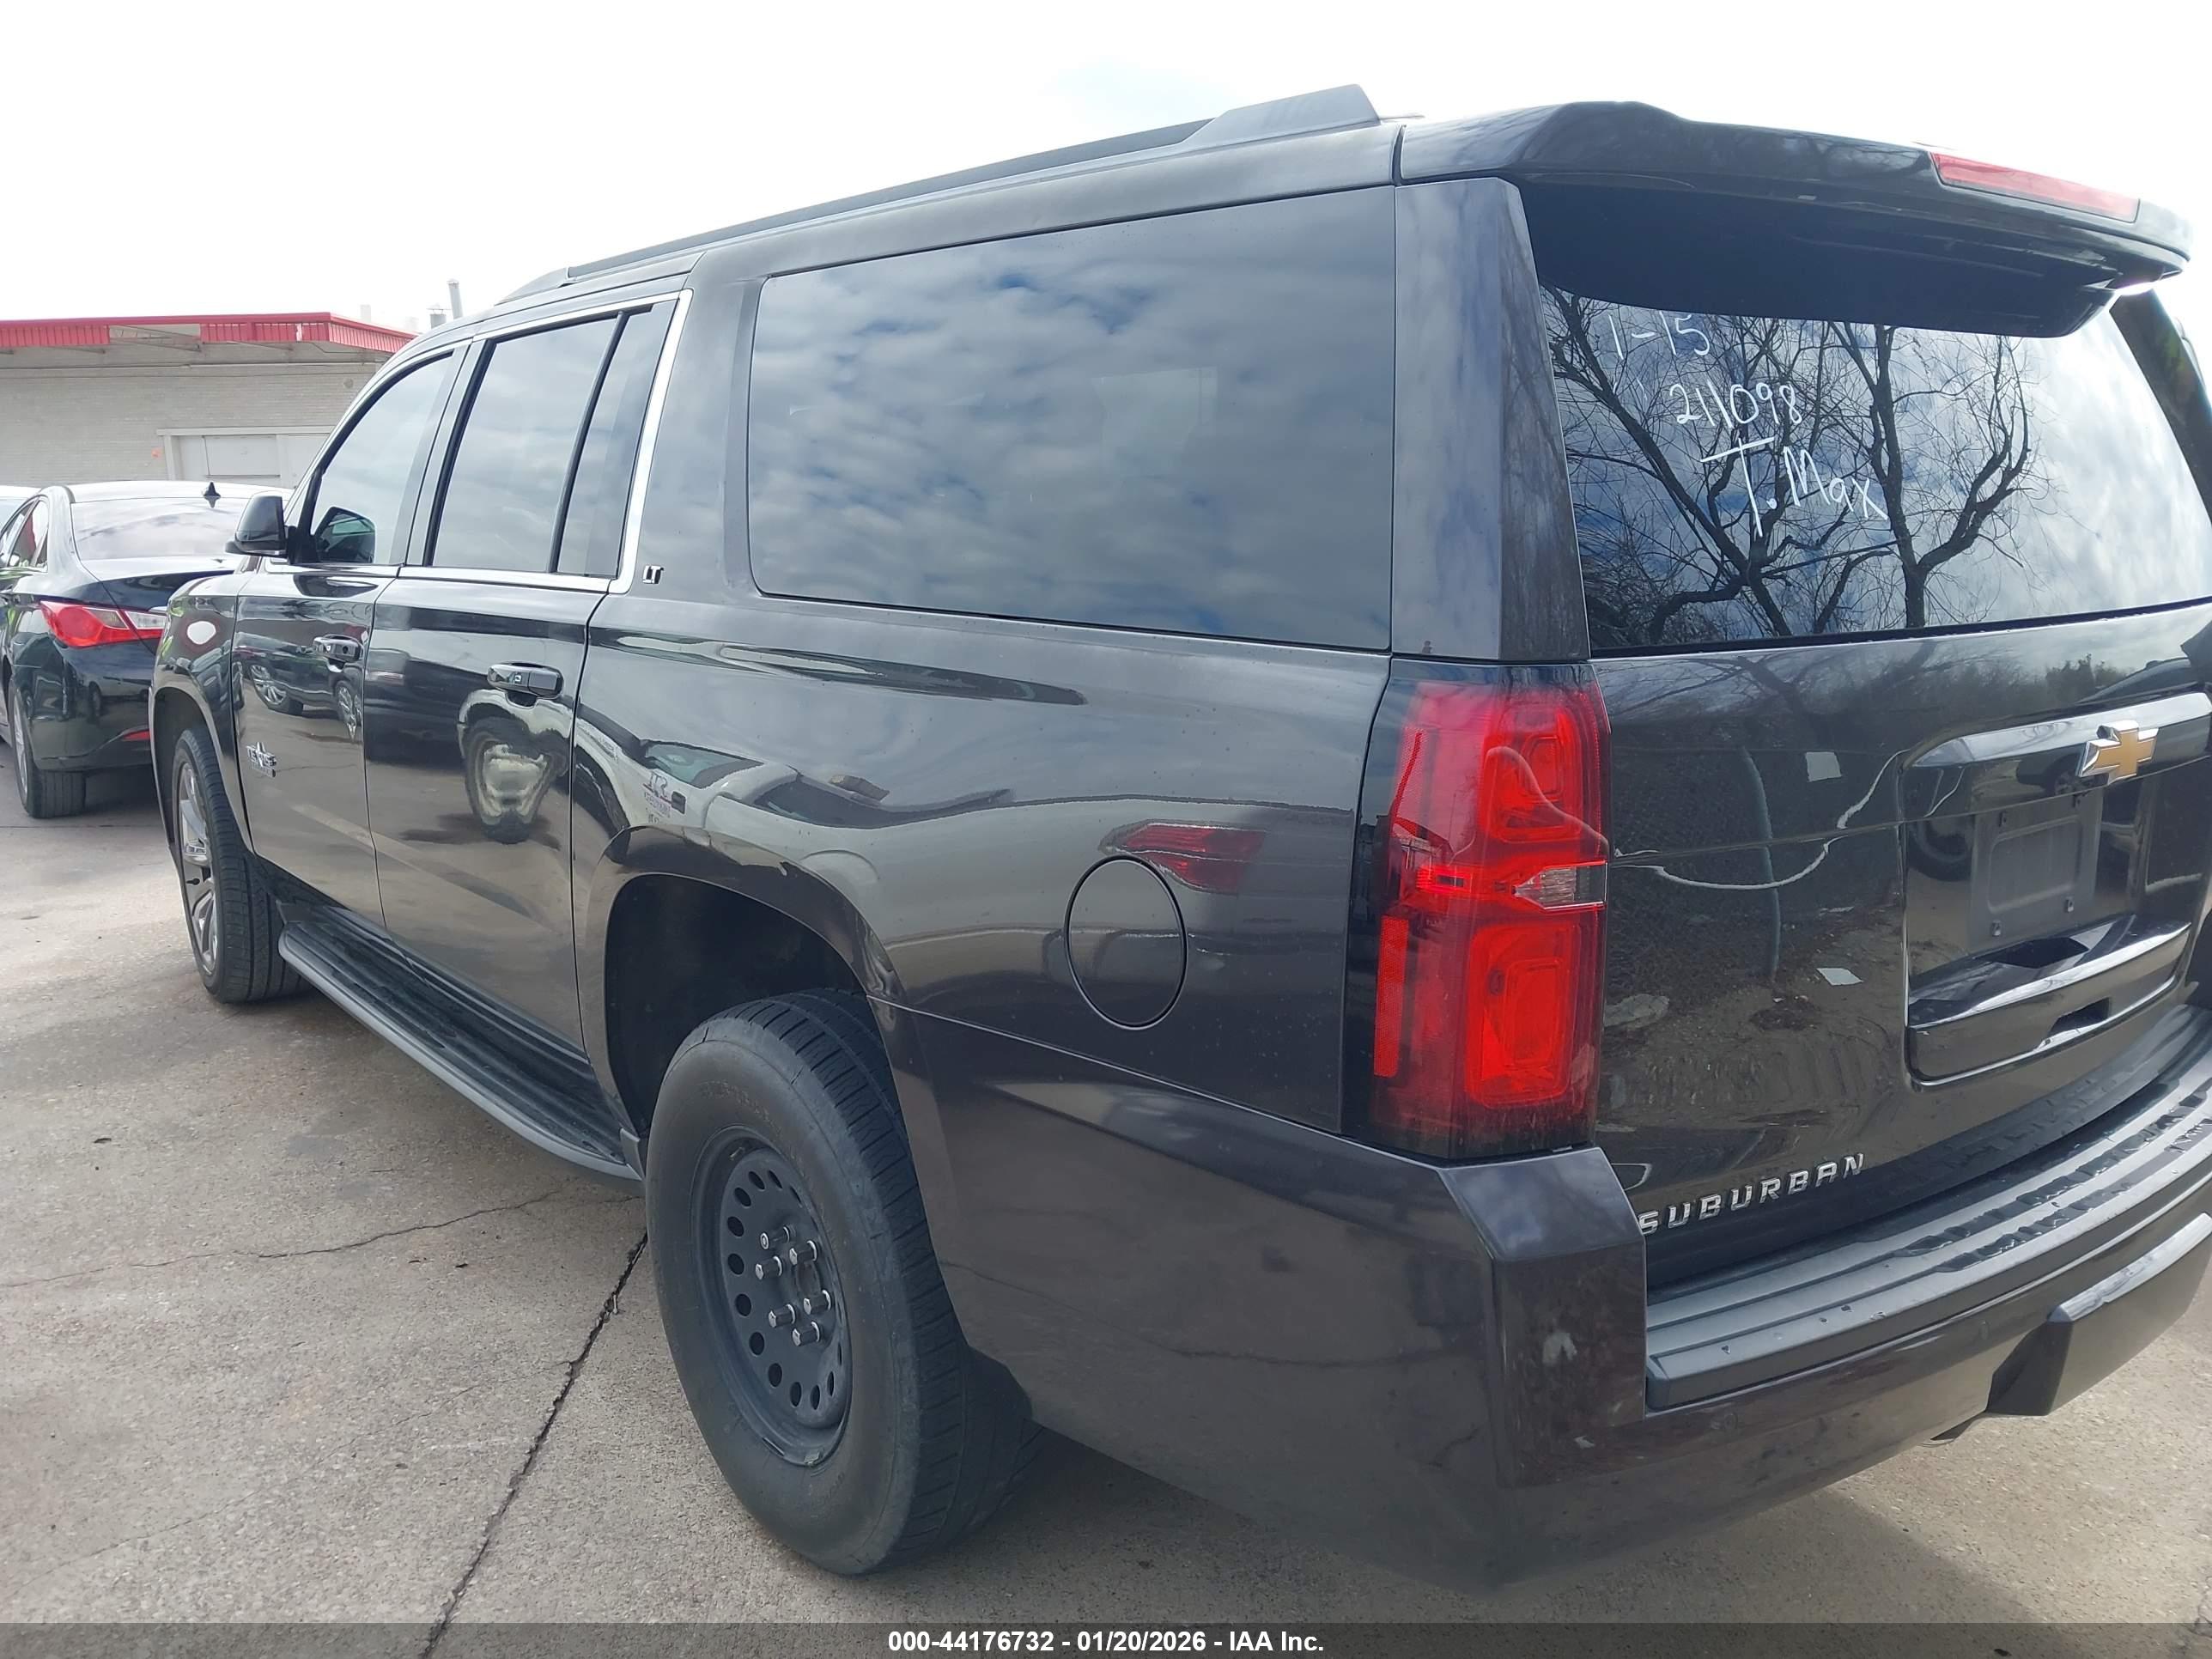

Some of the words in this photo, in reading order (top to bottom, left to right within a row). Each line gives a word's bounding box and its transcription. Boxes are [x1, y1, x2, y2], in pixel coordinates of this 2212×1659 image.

[1607, 310, 1711, 359] 1-15
[1668, 381, 1802, 428] 211098
[642, 565, 664, 585] LT
[1638, 1152, 1864, 1235] SUBURBAN
